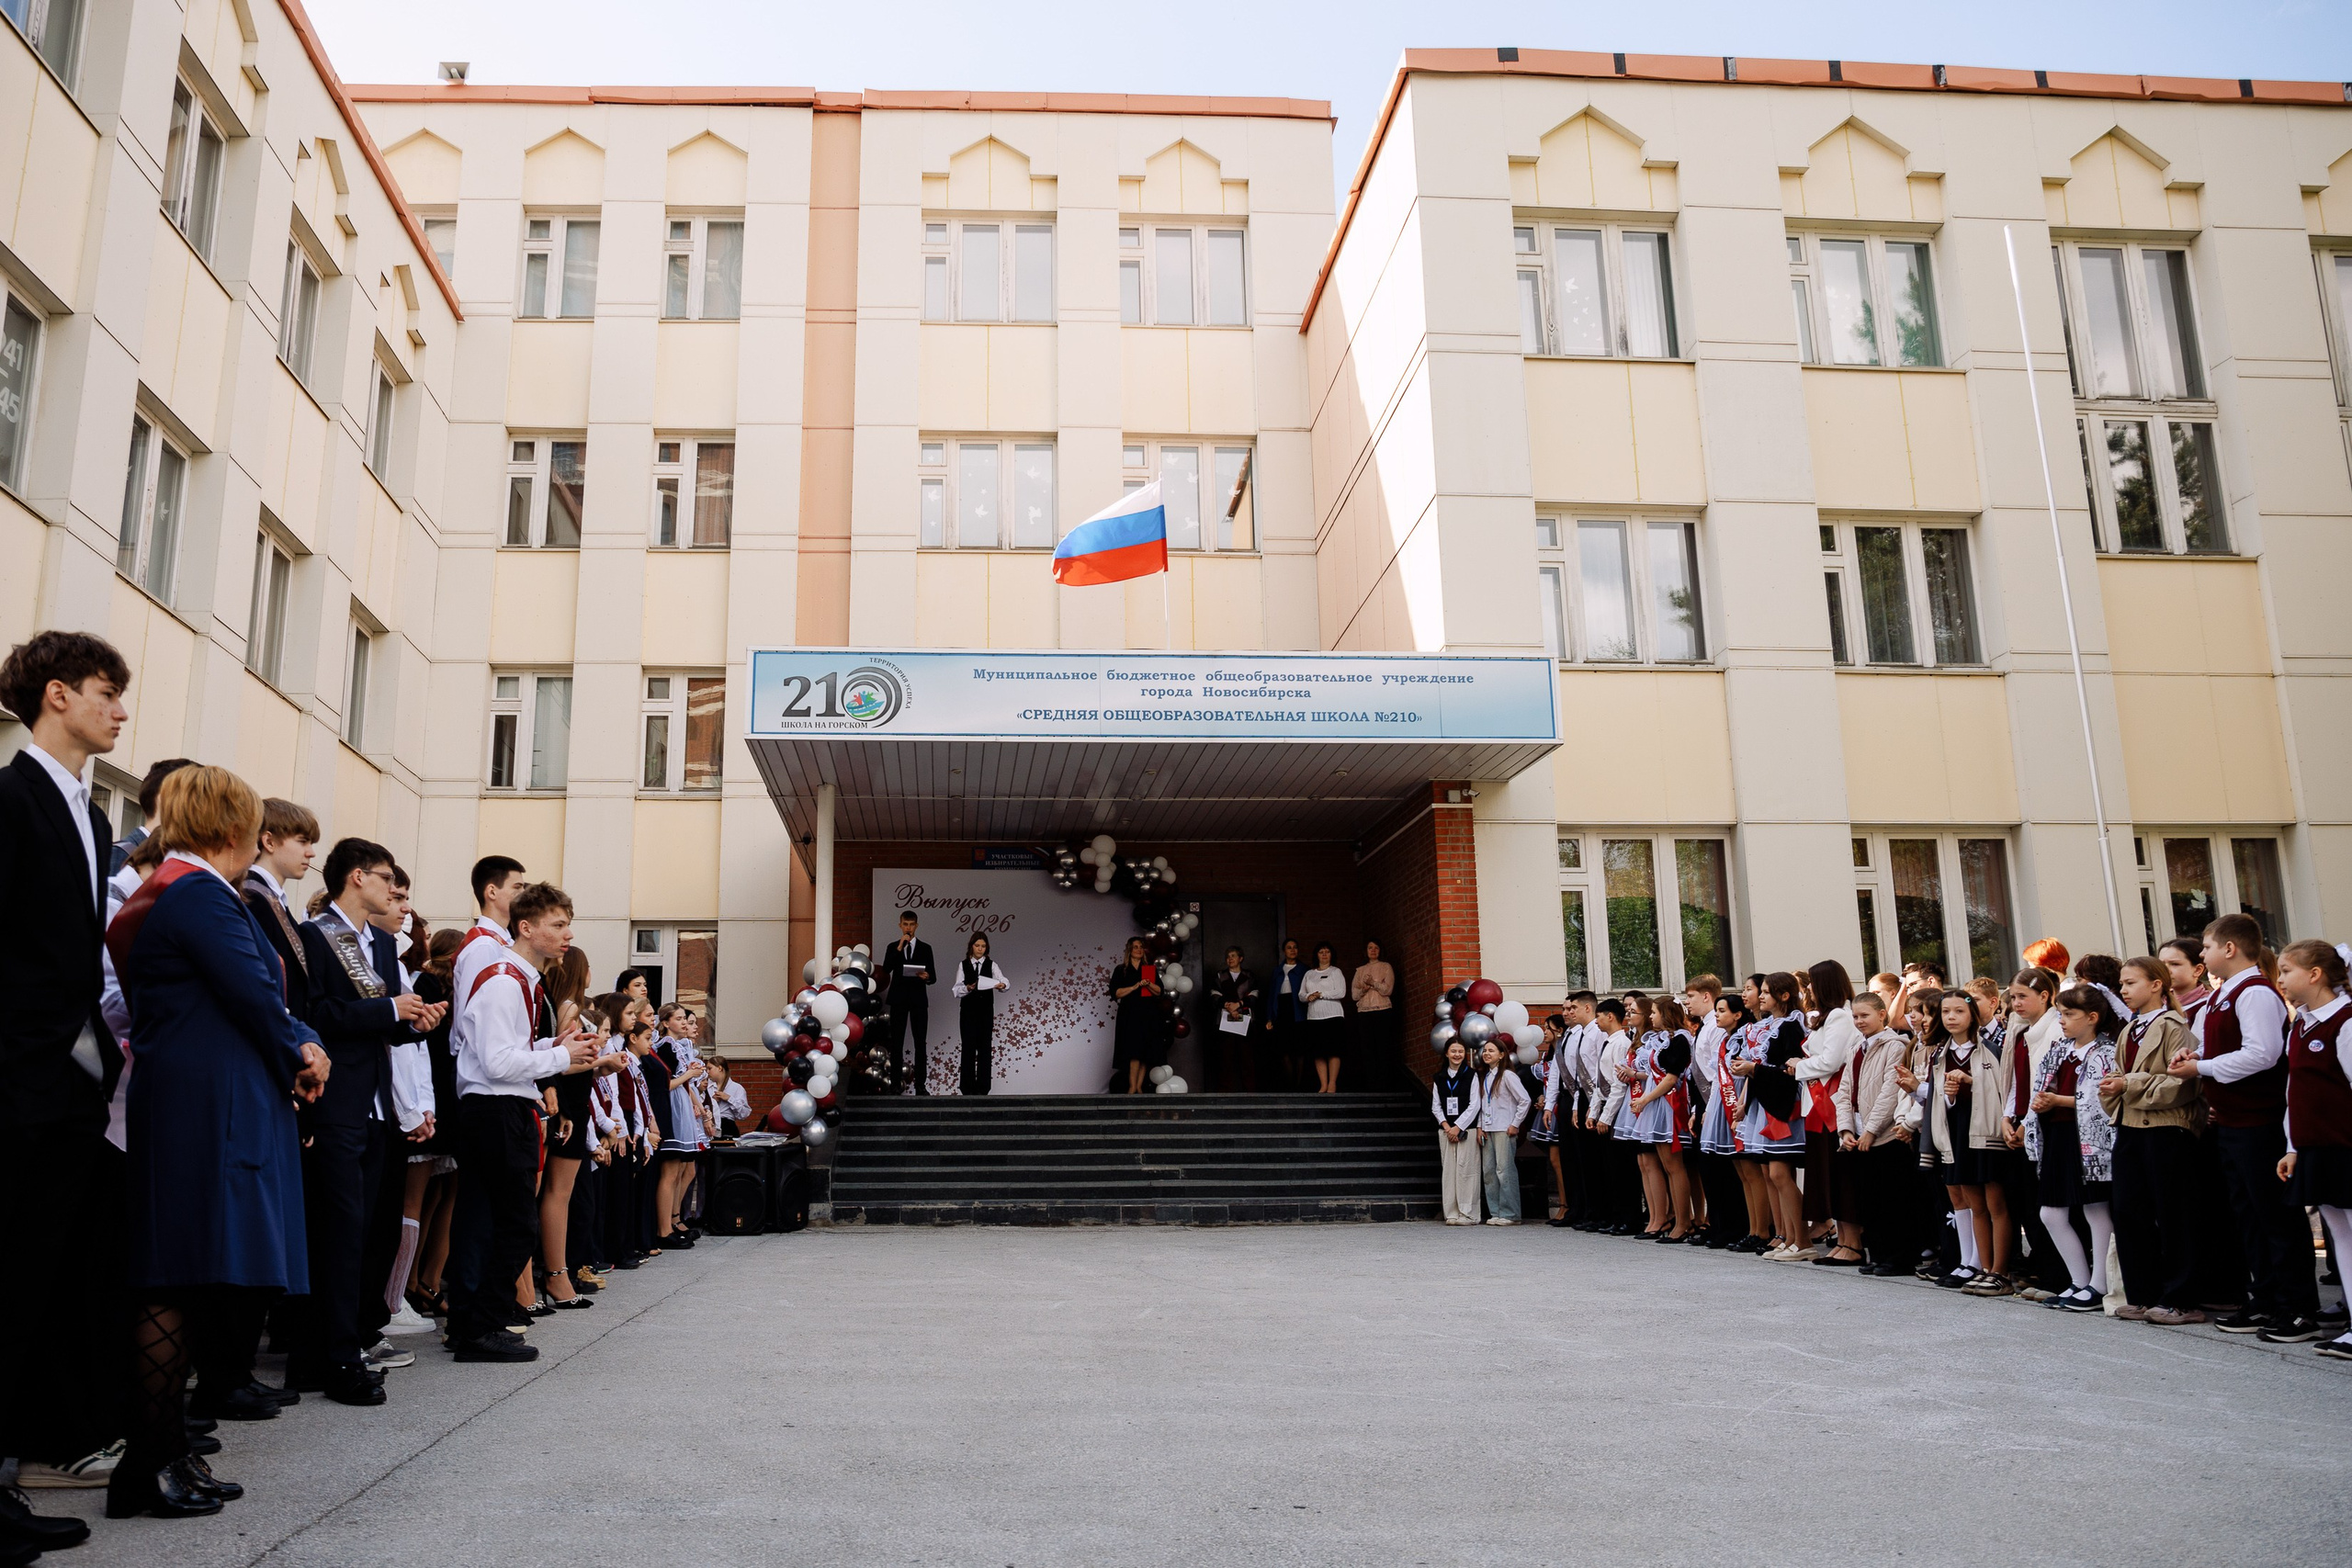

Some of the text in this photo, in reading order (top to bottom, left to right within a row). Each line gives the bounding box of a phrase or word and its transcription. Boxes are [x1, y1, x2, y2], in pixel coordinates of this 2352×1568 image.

[869, 657, 909, 683] ТЕРРИТОРИЯ
[973, 669, 1474, 684] Муниципальное бюджетное общеобразовательное учреждение
[782, 666, 903, 728] 210
[1141, 686, 1311, 700] города Новосибирска
[1017, 709, 1422, 723] «СРЕДНЯЯ ОБЩЕОБРАЗОВАТЕЛЬНАЯ ШКОЛА №210»
[895, 884, 990, 919] Выпуск
[956, 914, 1016, 933] 2026
